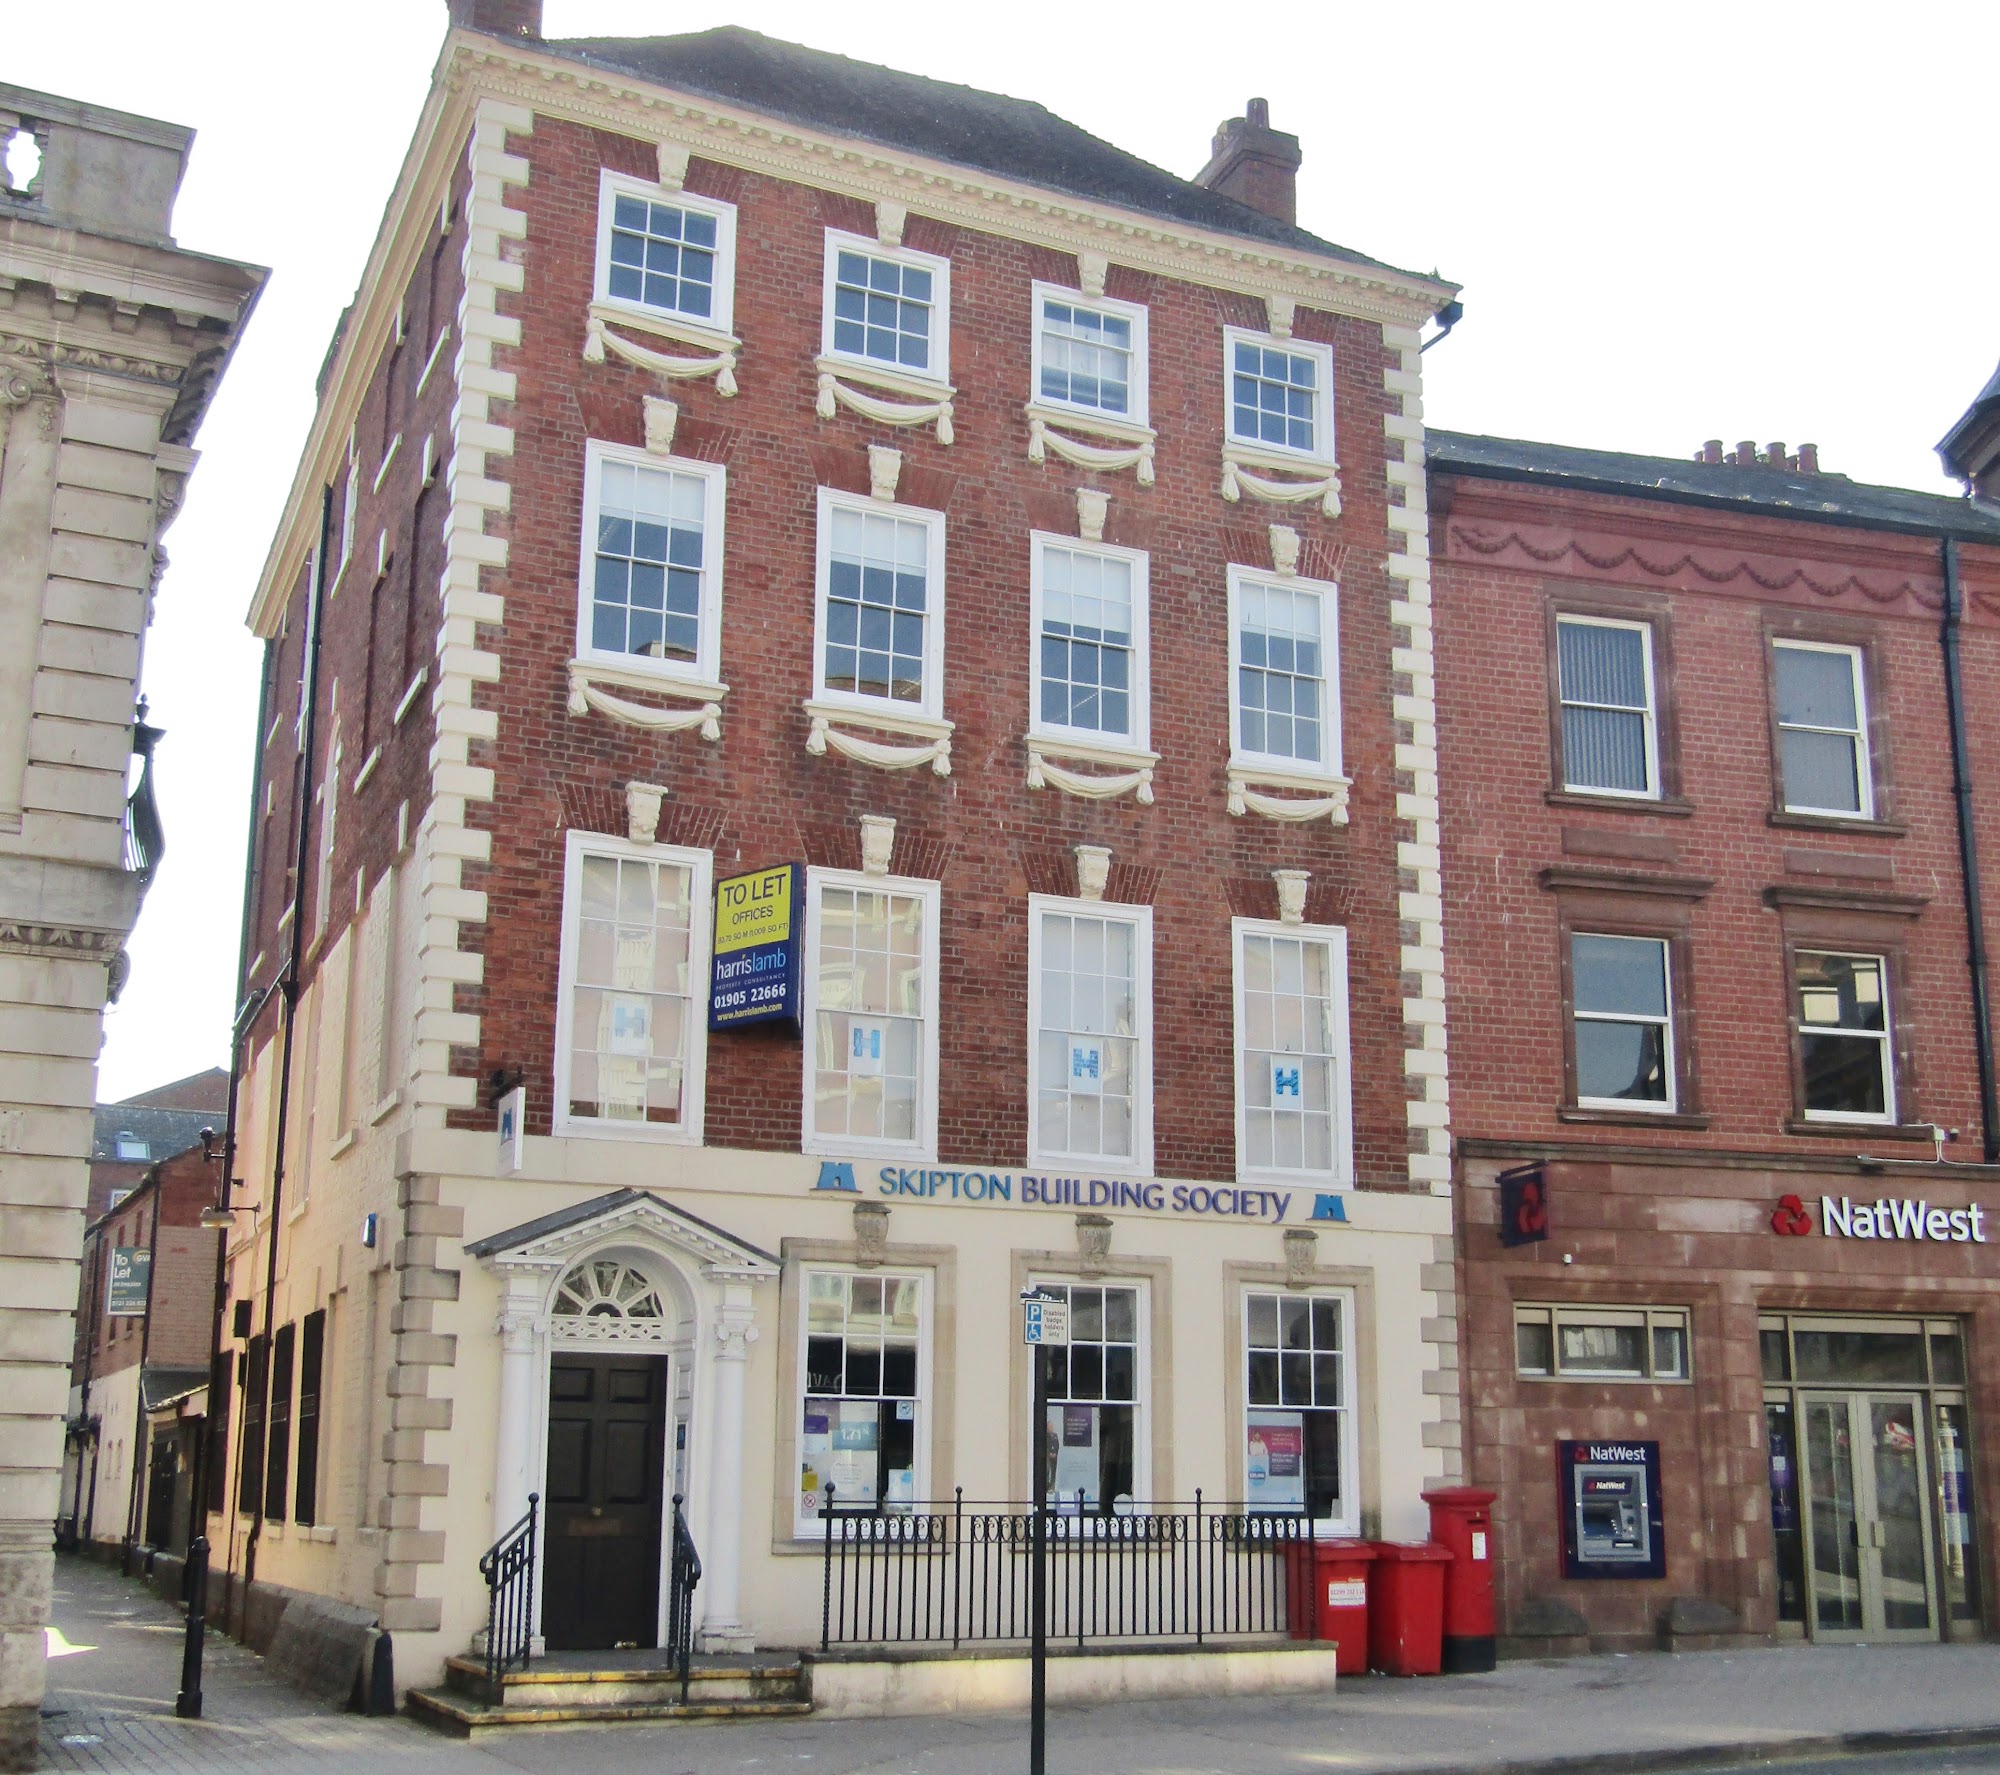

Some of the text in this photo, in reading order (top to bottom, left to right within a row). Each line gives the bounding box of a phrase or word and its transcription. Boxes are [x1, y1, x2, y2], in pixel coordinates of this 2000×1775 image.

[724, 873, 787, 907] TO LET
[732, 905, 774, 925] OFFICES
[716, 947, 787, 980] harrislamb
[716, 972, 786, 992] PROPERTY CONSULTANCY
[714, 982, 787, 1009] 01905 22666
[717, 1003, 783, 1021] www.harrislamb.com
[878, 1166, 1292, 1224] SKIPTON BUILDING SOCIETY
[1820, 1194, 1986, 1243] NatWest
[116, 1254, 128, 1266] To
[114, 1266, 132, 1279] Let
[1043, 1309, 1065, 1317] Disabled
[1046, 1316, 1062, 1325] badge
[1044, 1323, 1064, 1331] holders
[1590, 1446, 1647, 1461] NatWest
[1596, 1481, 1626, 1490] NatWest
